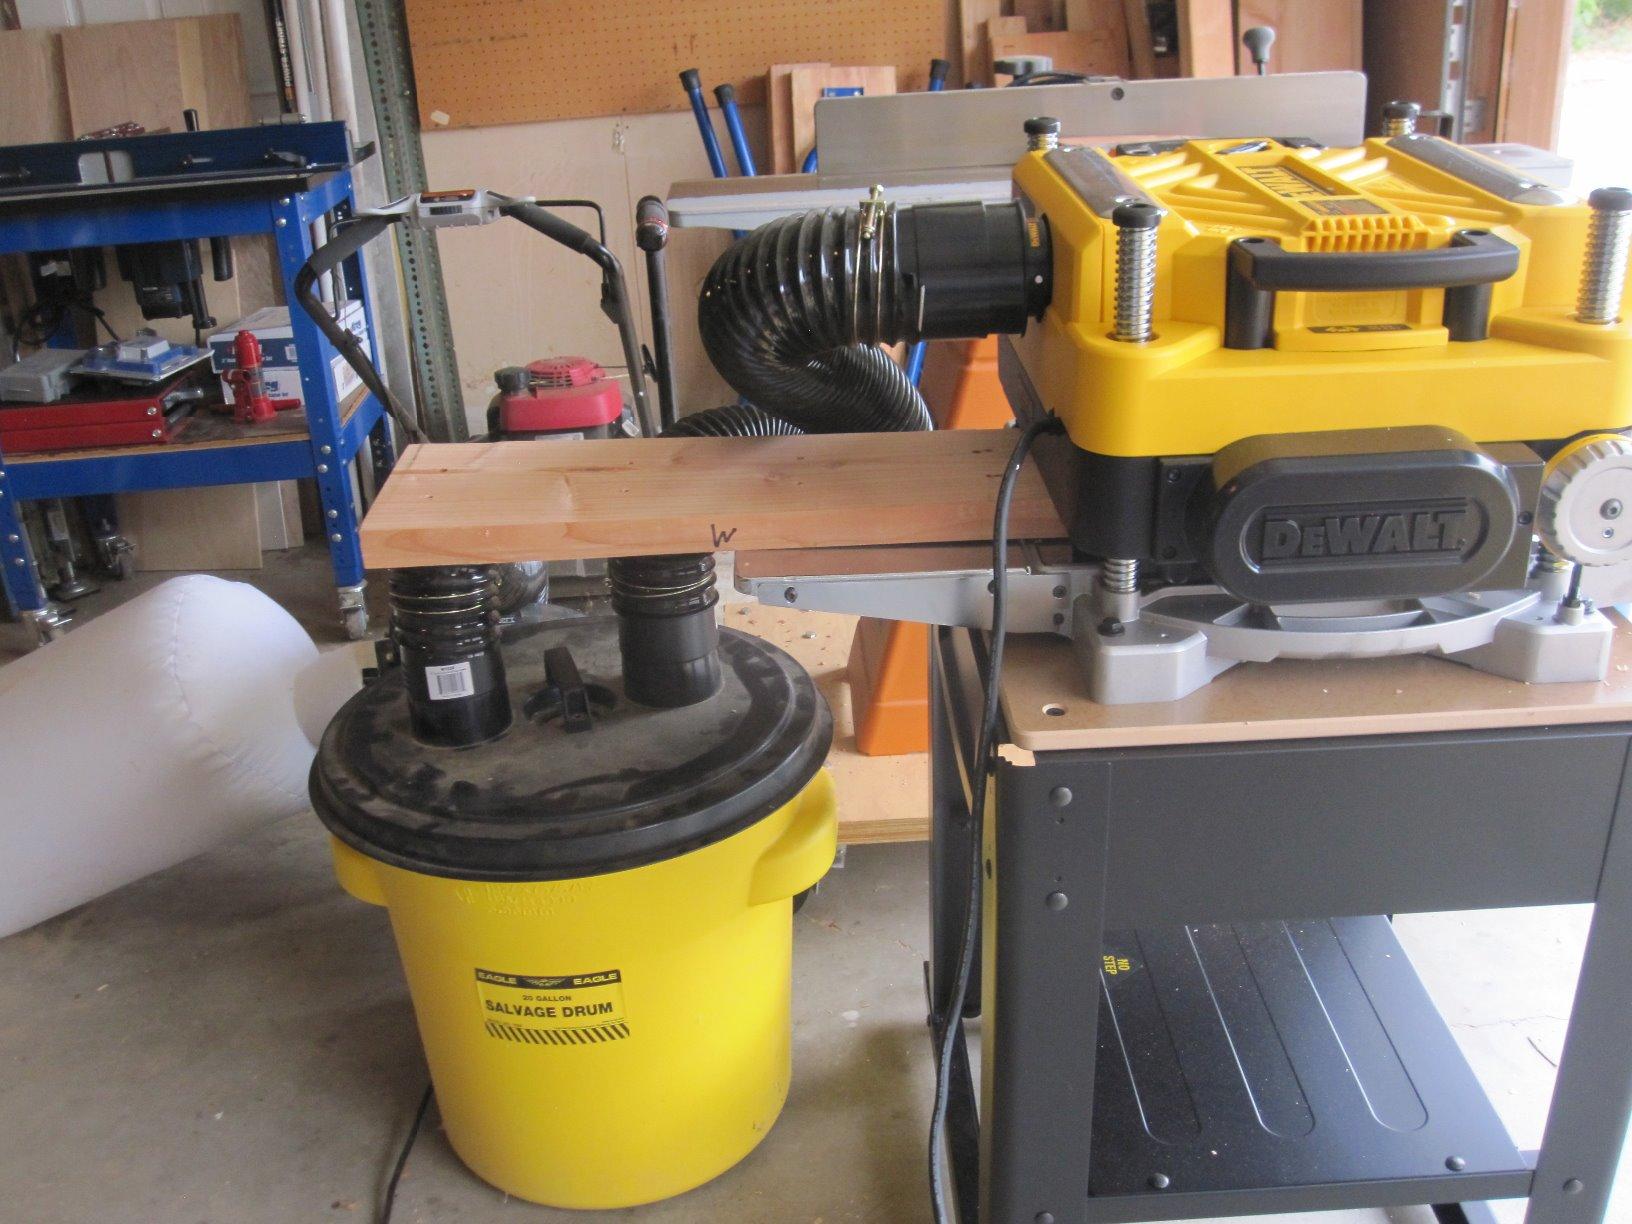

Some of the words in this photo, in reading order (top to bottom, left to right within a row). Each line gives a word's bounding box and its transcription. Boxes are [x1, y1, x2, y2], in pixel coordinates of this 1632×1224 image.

[710, 523, 737, 547] W
[1103, 955, 1118, 975] STEP
[1117, 958, 1130, 971] NO
[477, 971, 518, 985] EAGLE
[573, 973, 618, 985] EAGLE
[536, 994, 572, 1002] GALLON
[485, 999, 557, 1018] SALVAGE
[562, 1001, 613, 1018] DRUM
